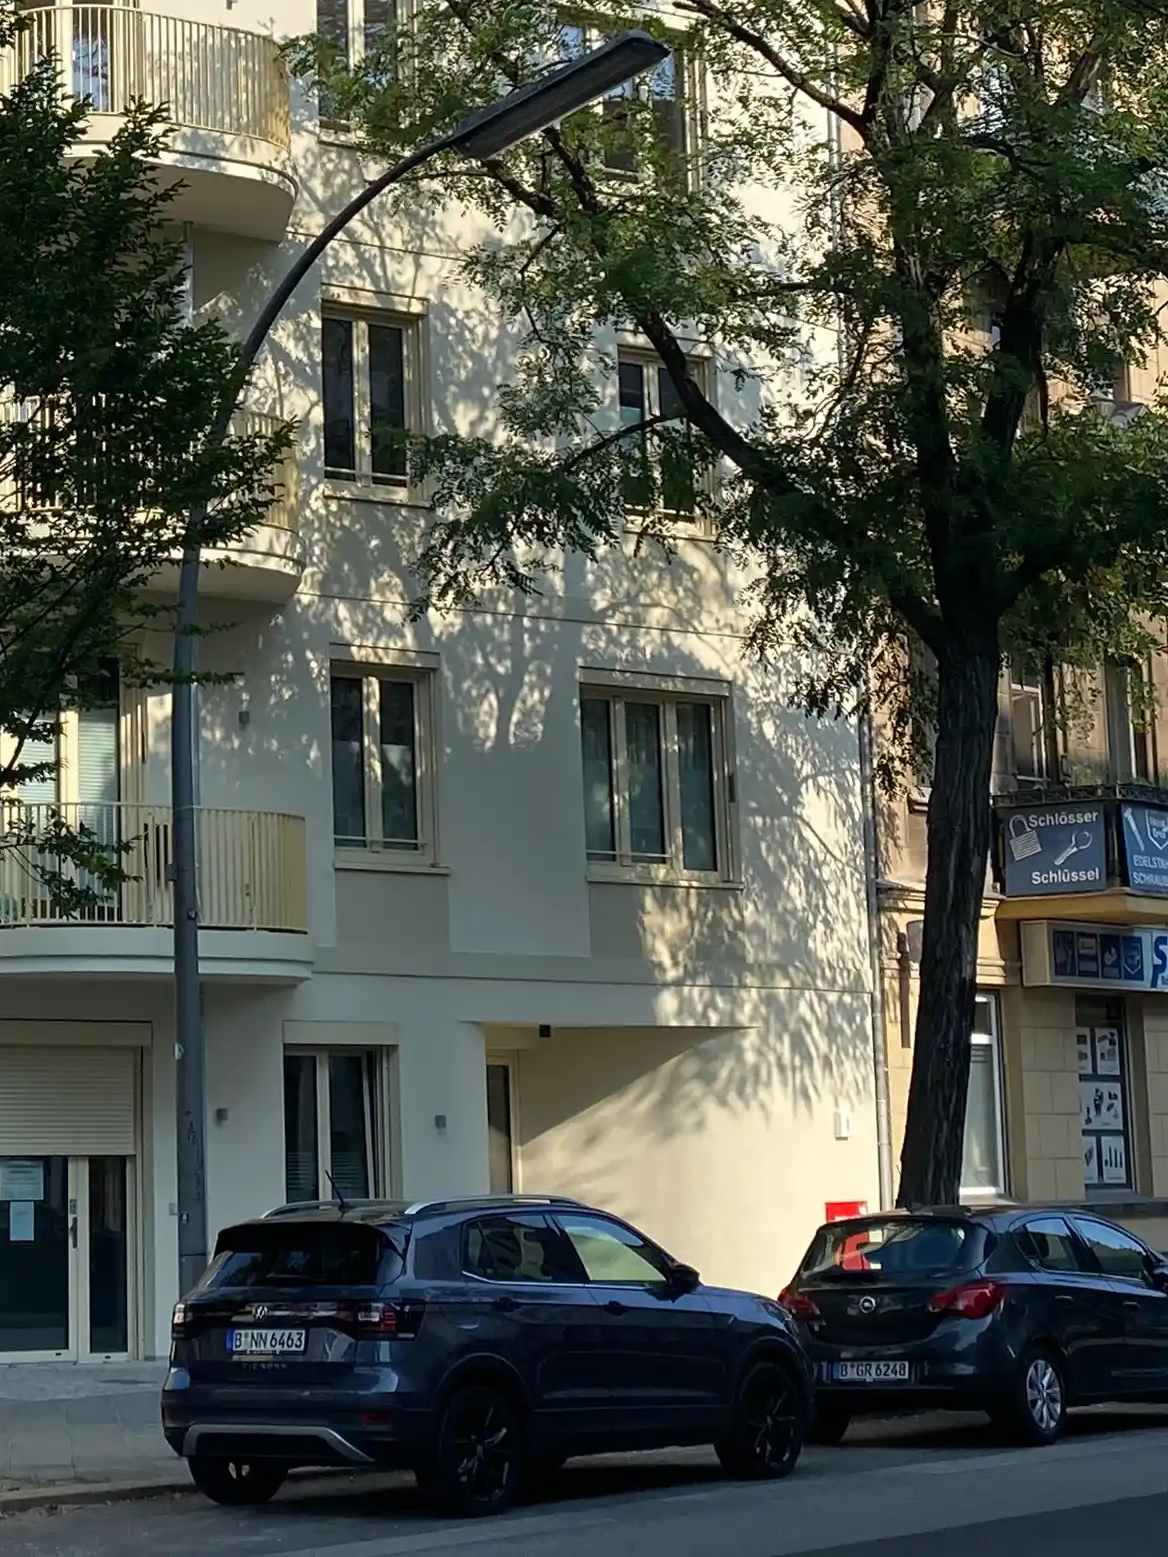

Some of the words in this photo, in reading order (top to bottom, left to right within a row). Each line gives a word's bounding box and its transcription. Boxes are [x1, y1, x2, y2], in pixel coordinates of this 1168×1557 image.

[1028, 811, 1099, 828] Schlösser
[1031, 866, 1100, 885] Schlüssel
[269, 1332, 303, 1348] 6463
[875, 1362, 906, 1377] 6248
